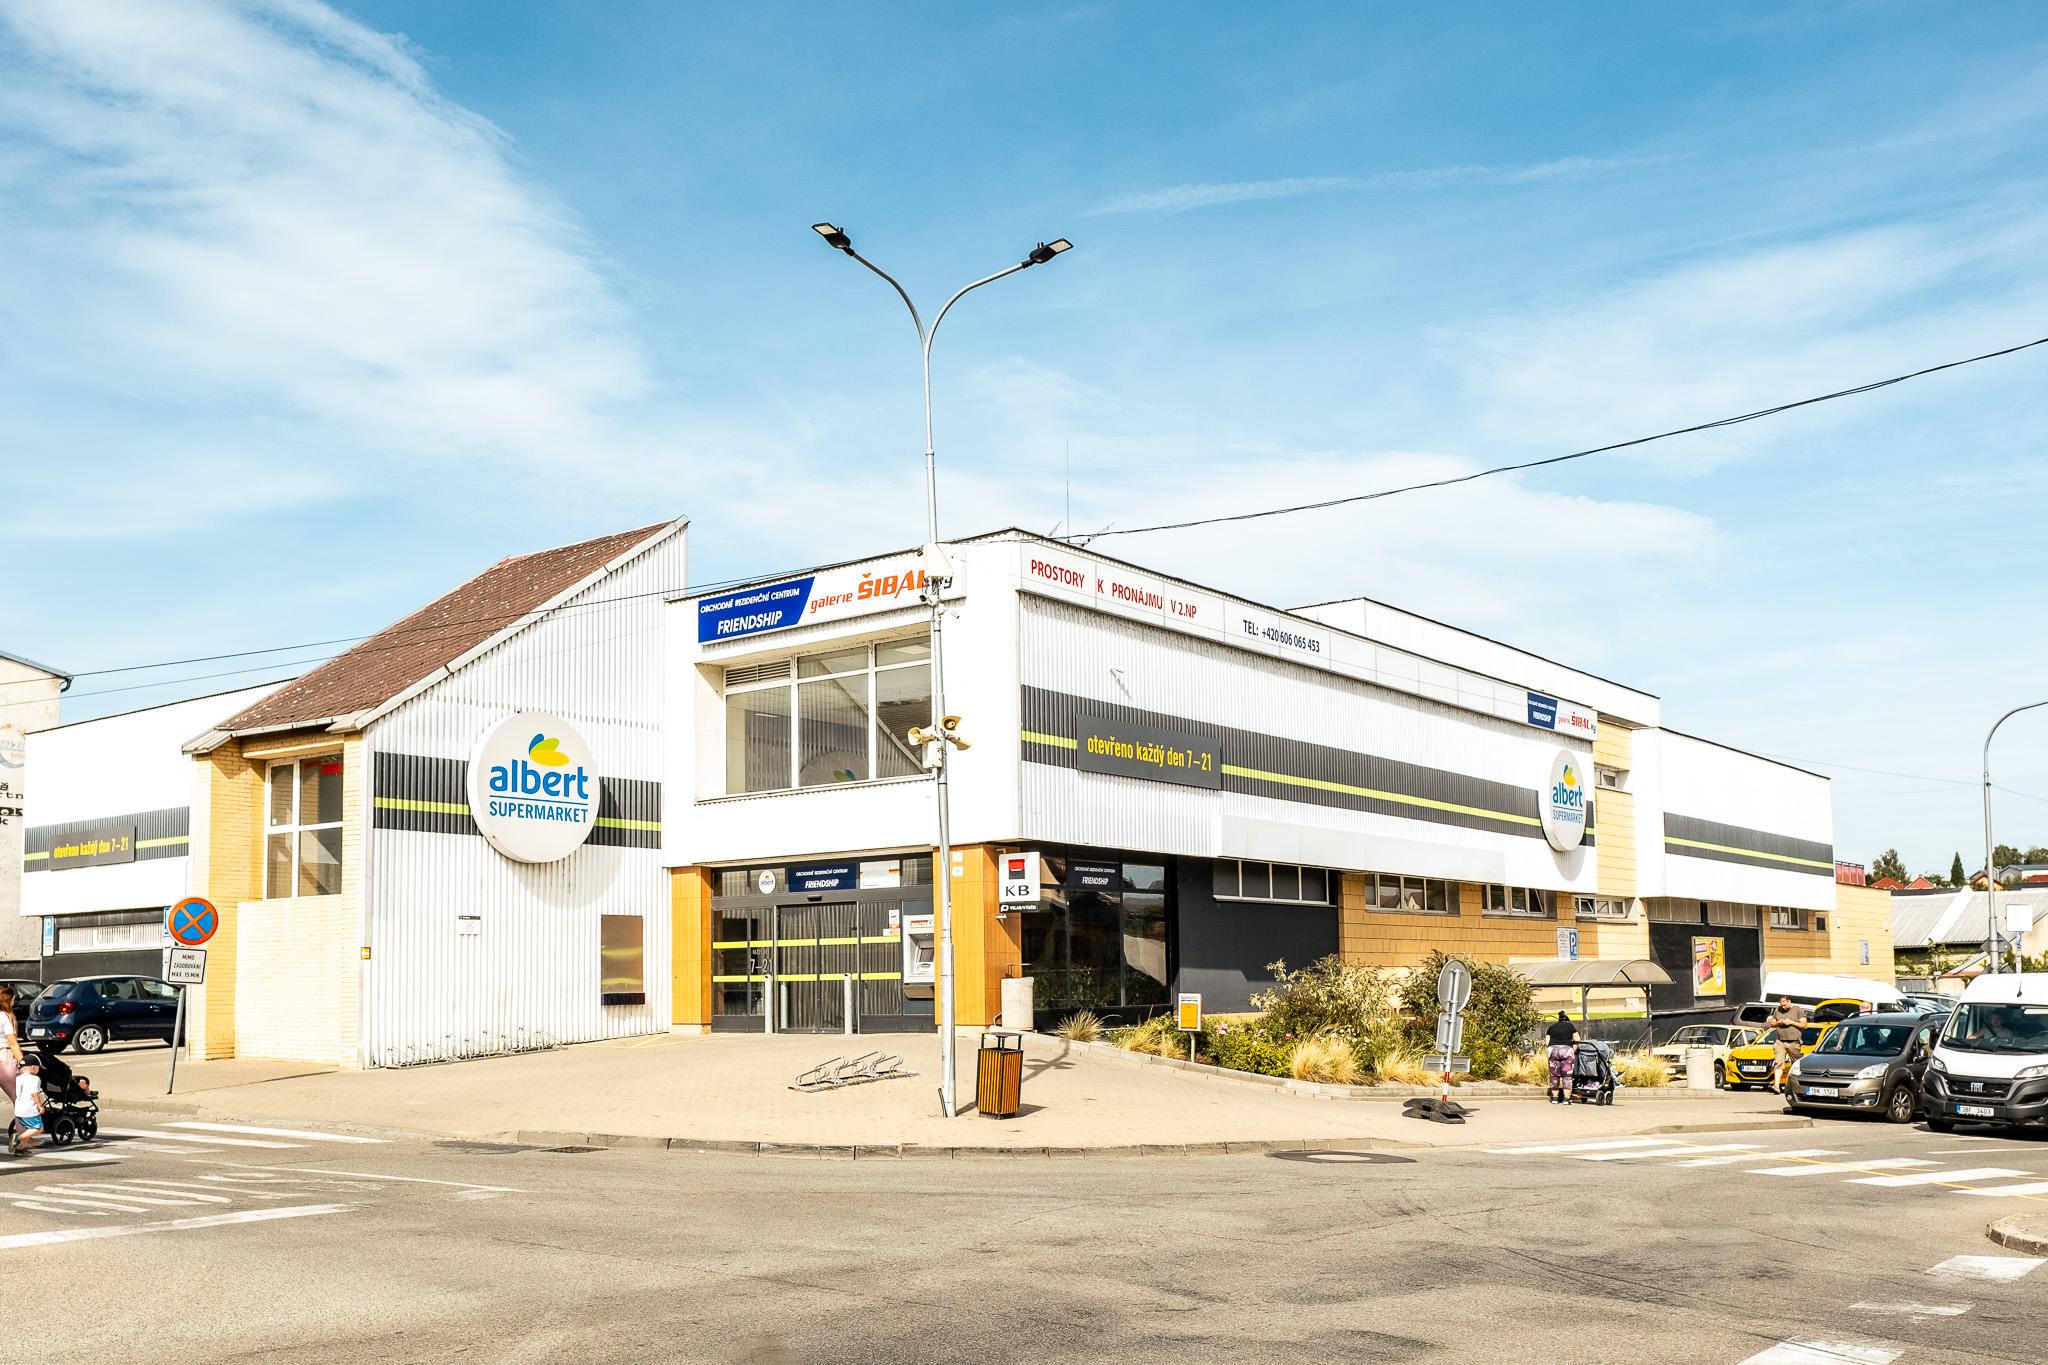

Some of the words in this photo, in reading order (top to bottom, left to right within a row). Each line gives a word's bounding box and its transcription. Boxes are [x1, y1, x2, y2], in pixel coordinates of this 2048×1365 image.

[735, 592, 770, 607] REZIDENČNÍ
[771, 588, 800, 600] CENTRUM
[1031, 559, 1085, 588] PROSTORY
[1097, 578, 1104, 594] K
[1112, 582, 1163, 609] PRONÁJMU
[1170, 600, 1177, 613] V
[1178, 602, 1197, 618] 2.NP
[810, 593, 853, 613] galerie
[717, 611, 783, 635] FRIENDSHIP
[1243, 619, 1259, 636] TEL:
[1262, 627, 1280, 641] +420
[1280, 631, 1293, 645] 606
[1294, 635, 1306, 649] 065
[1308, 639, 1320, 652] 453
[1087, 735, 1134, 759] otevřeno
[1136, 741, 1165, 768] každý
[1167, 747, 1184, 767] den
[489, 758, 589, 800] albert
[1552, 781, 1583, 808] albert
[489, 801, 589, 823] SUPERMARKET
[1552, 809, 1583, 824] SUPERMARKET
[805, 879, 839, 889] FRIENDSHIP
[1005, 885, 1030, 896] KB
[1082, 876, 1109, 885] FRIENDSHIP
